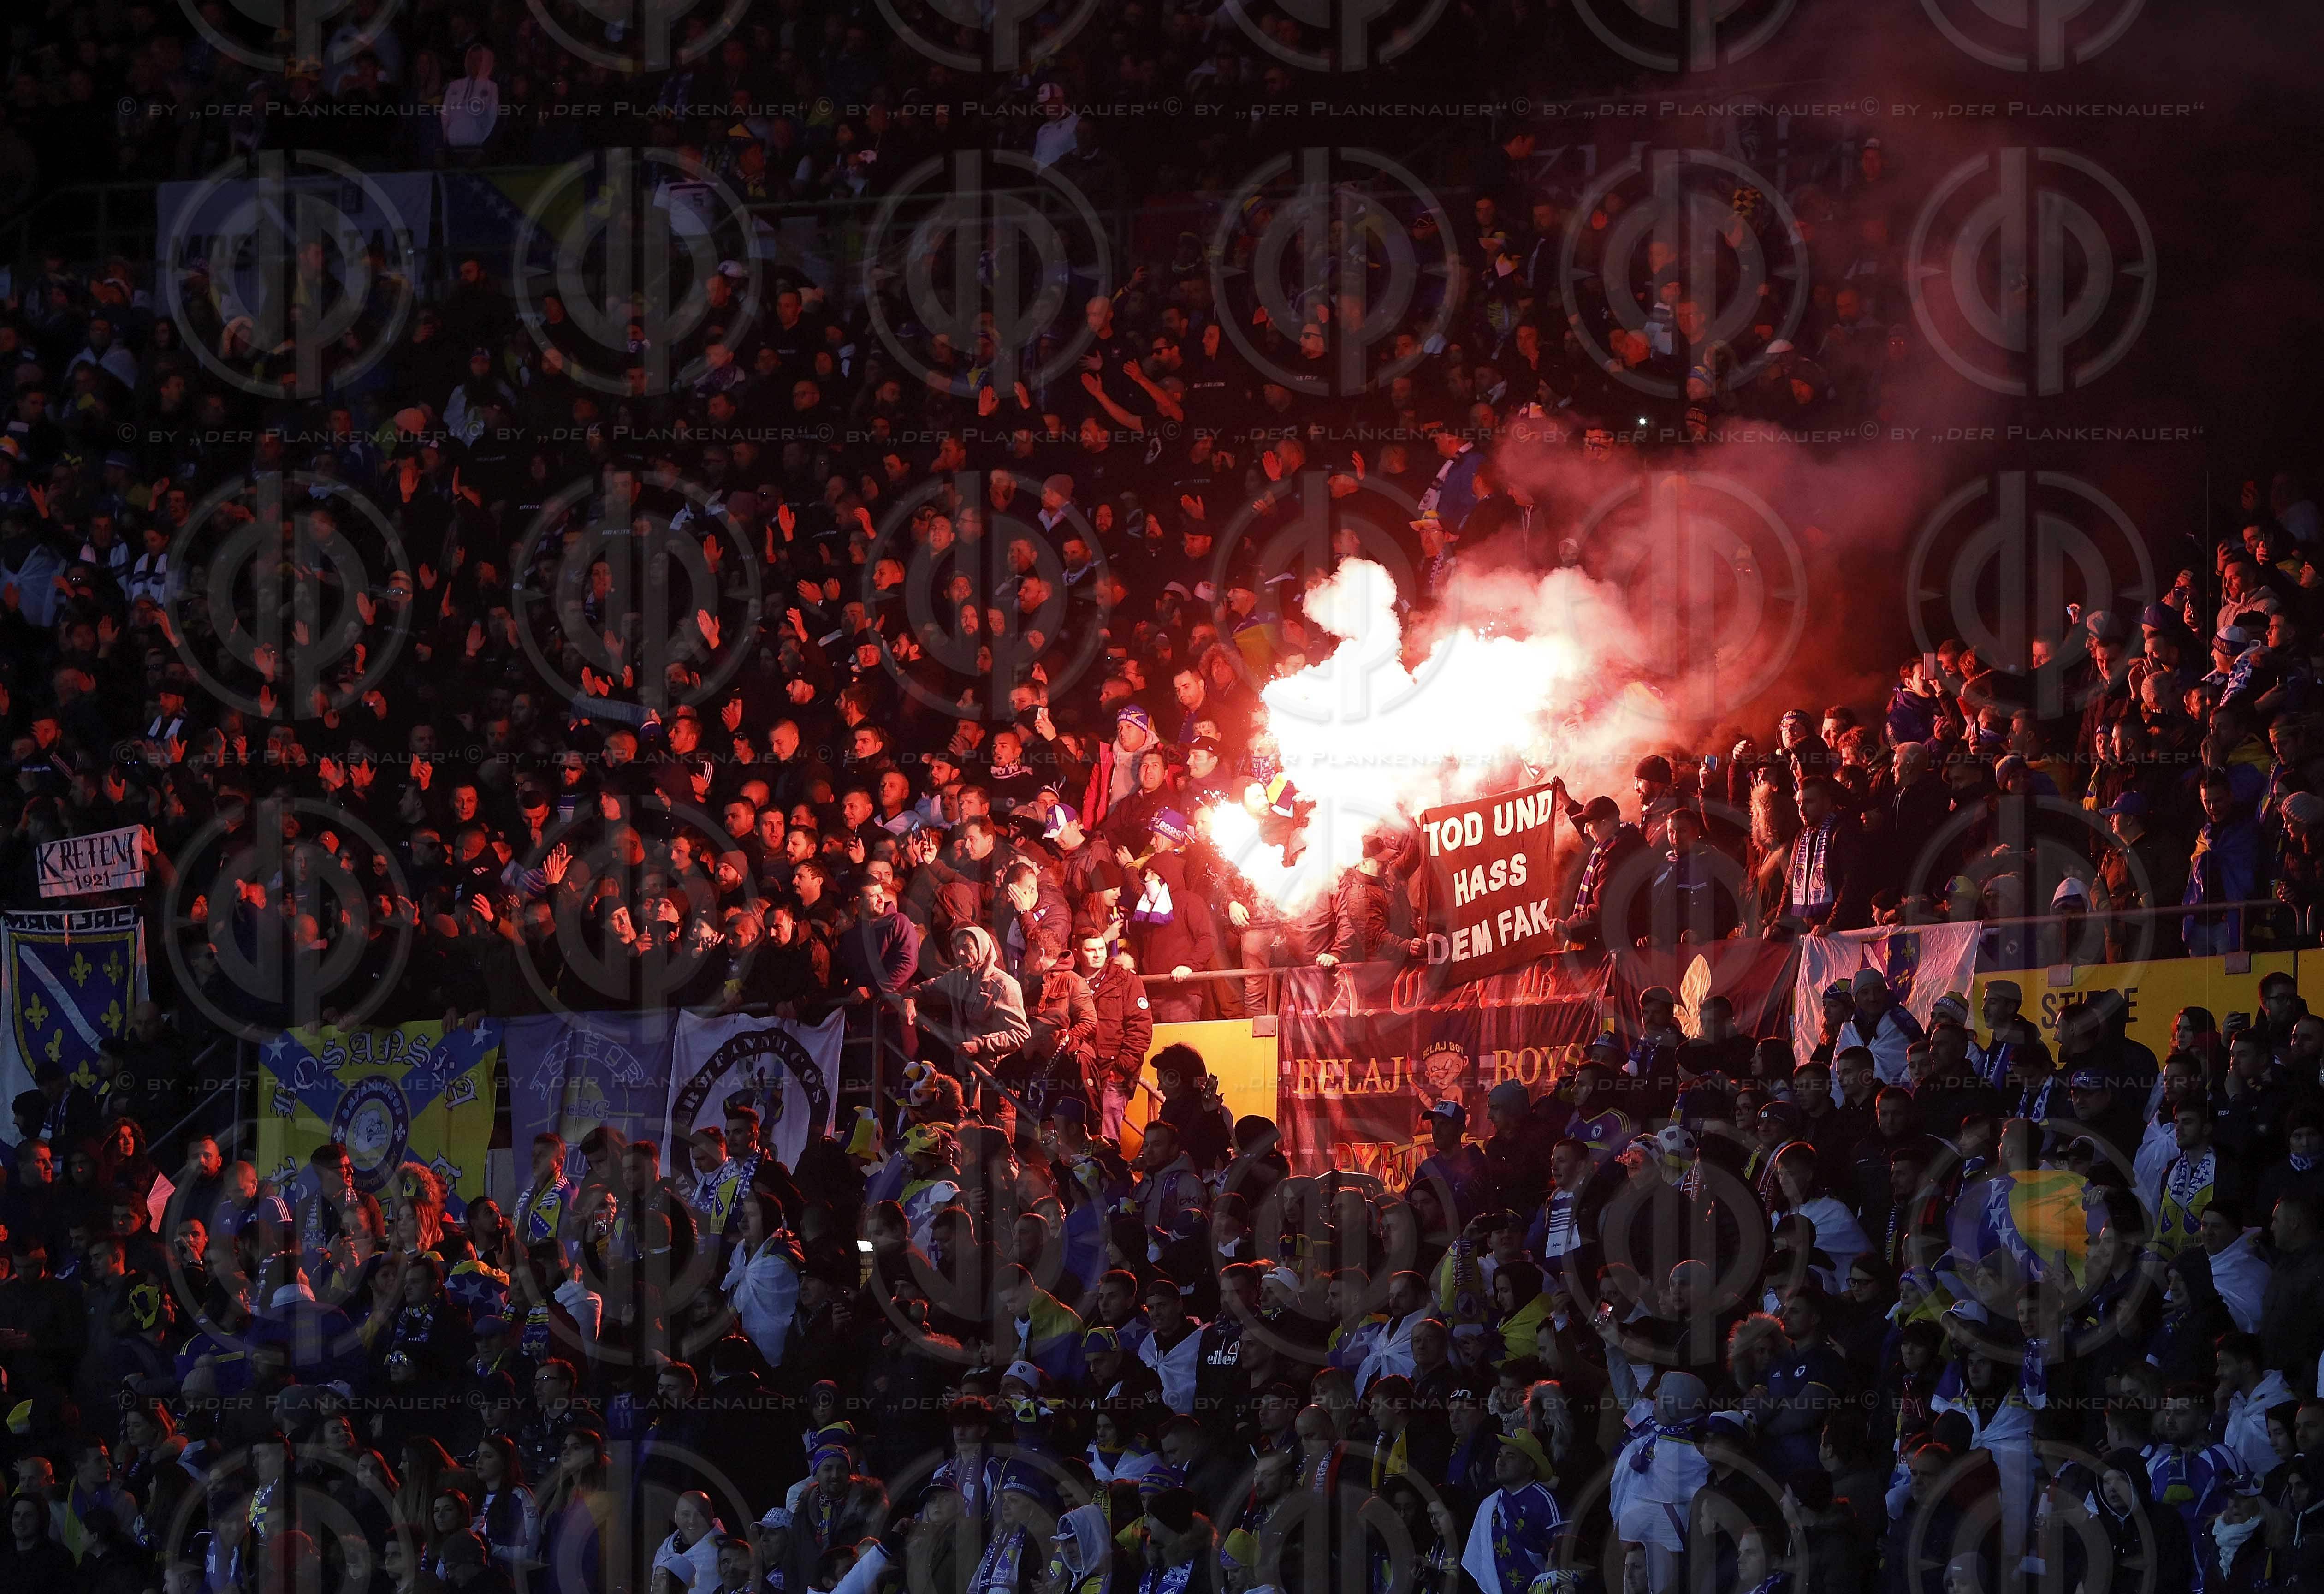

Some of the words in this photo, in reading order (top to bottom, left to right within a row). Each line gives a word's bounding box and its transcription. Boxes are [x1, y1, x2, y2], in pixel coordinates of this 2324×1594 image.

[1423, 811, 1483, 857] TOD
[1494, 789, 1553, 837] UND
[36, 832, 135, 879] KRETENI
[75, 870, 111, 891] 1921
[1453, 852, 1527, 908] HASS
[1426, 919, 1493, 965] DEM
[1497, 898, 1550, 946] FAK
[1293, 1056, 1405, 1095] BELAJ
[1492, 1042, 1588, 1087] BOYS
